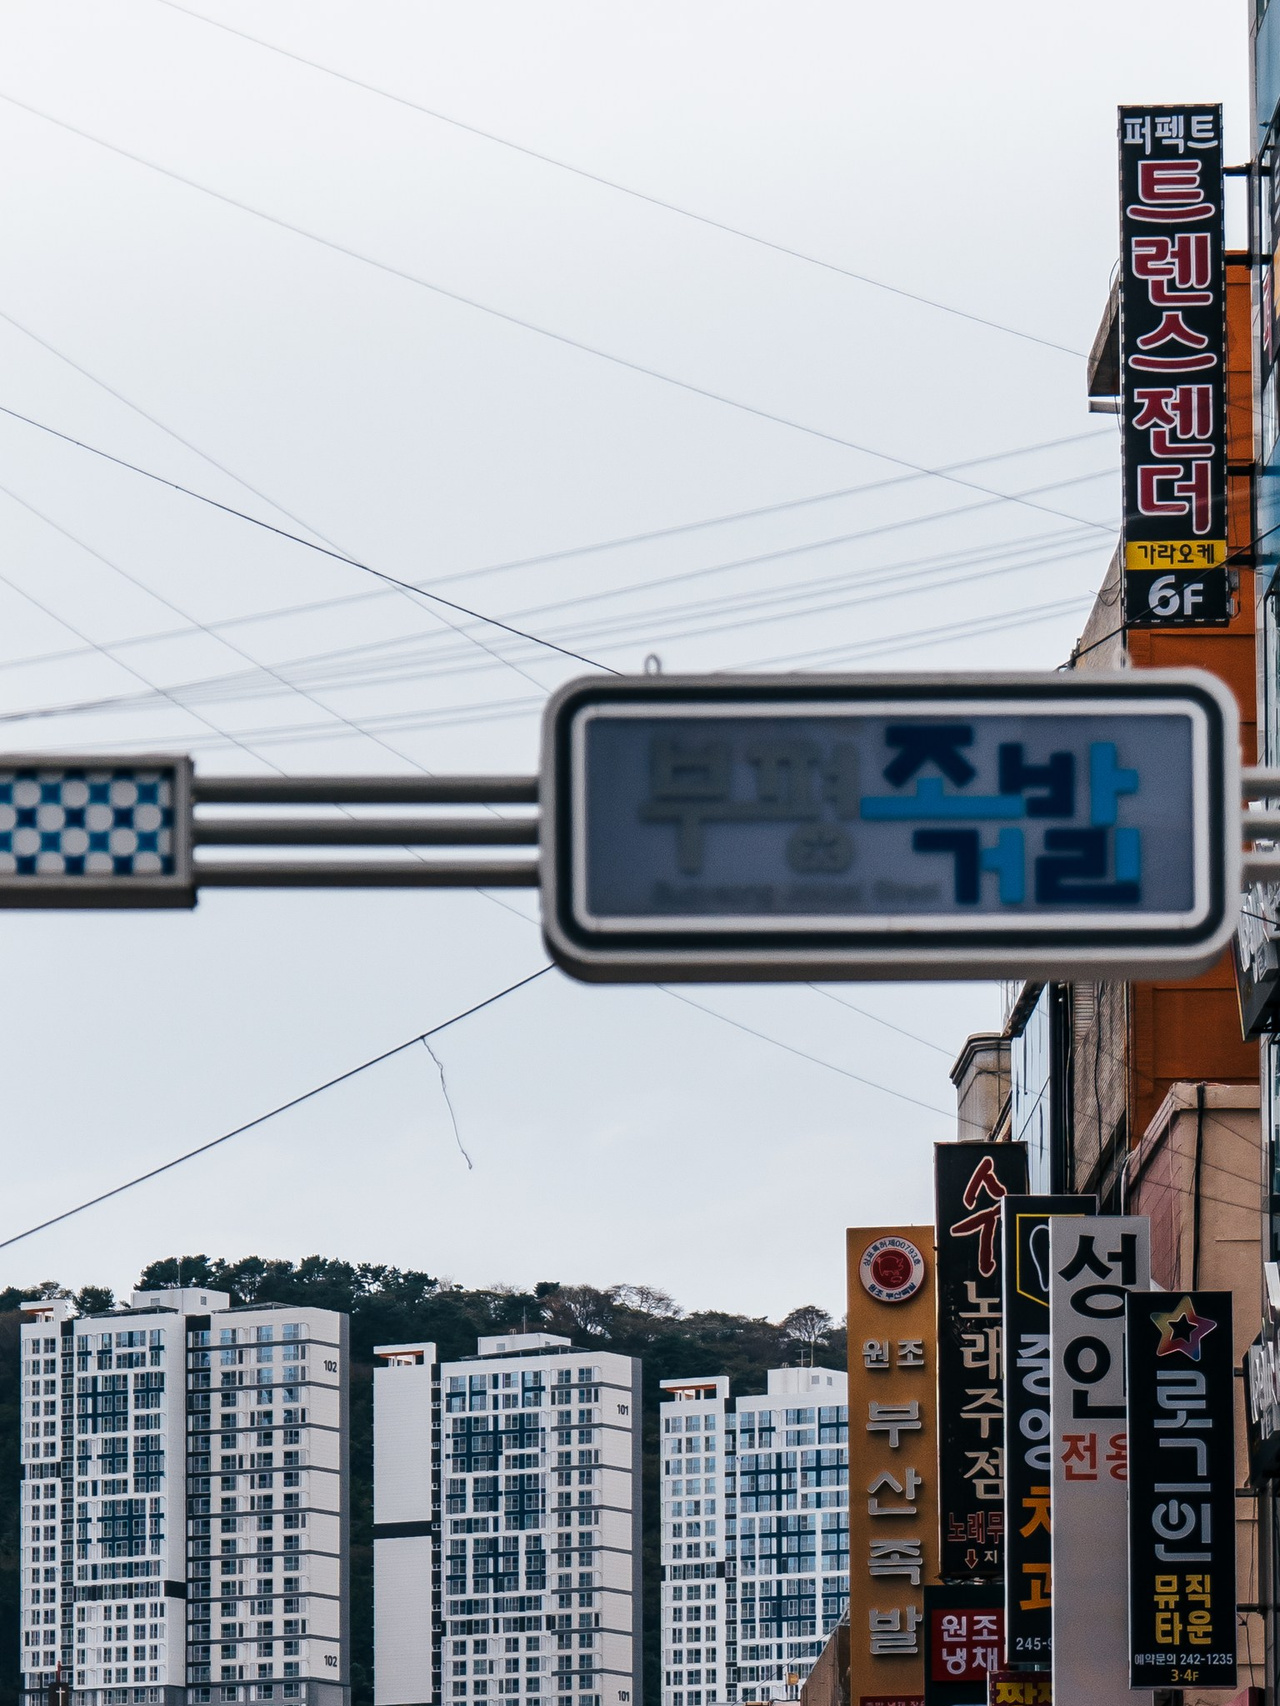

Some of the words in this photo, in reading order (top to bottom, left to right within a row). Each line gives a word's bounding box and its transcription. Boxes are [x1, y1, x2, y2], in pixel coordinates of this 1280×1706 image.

[1124, 114, 1218, 155] 퍼펙트
[1126, 159, 1219, 535] 트렌스젠더
[1137, 543, 1215, 565] 가라오케
[1147, 574, 1203, 617] 6F
[1058, 1233, 1135, 1421] 성인
[862, 1336, 925, 1369] 원조
[958, 1280, 1005, 1499] 노래주점
[1153, 1369, 1213, 1562] 로그인
[866, 1400, 924, 1657] 부산족발
[1153, 1574, 1212, 1608] 뮤직
[940, 1613, 999, 1643] 원조
[1154, 1611, 1213, 1647] 타운
[1133, 1653, 1175, 1667] 예약문의
[1179, 1653, 1234, 1667] 242-1235
